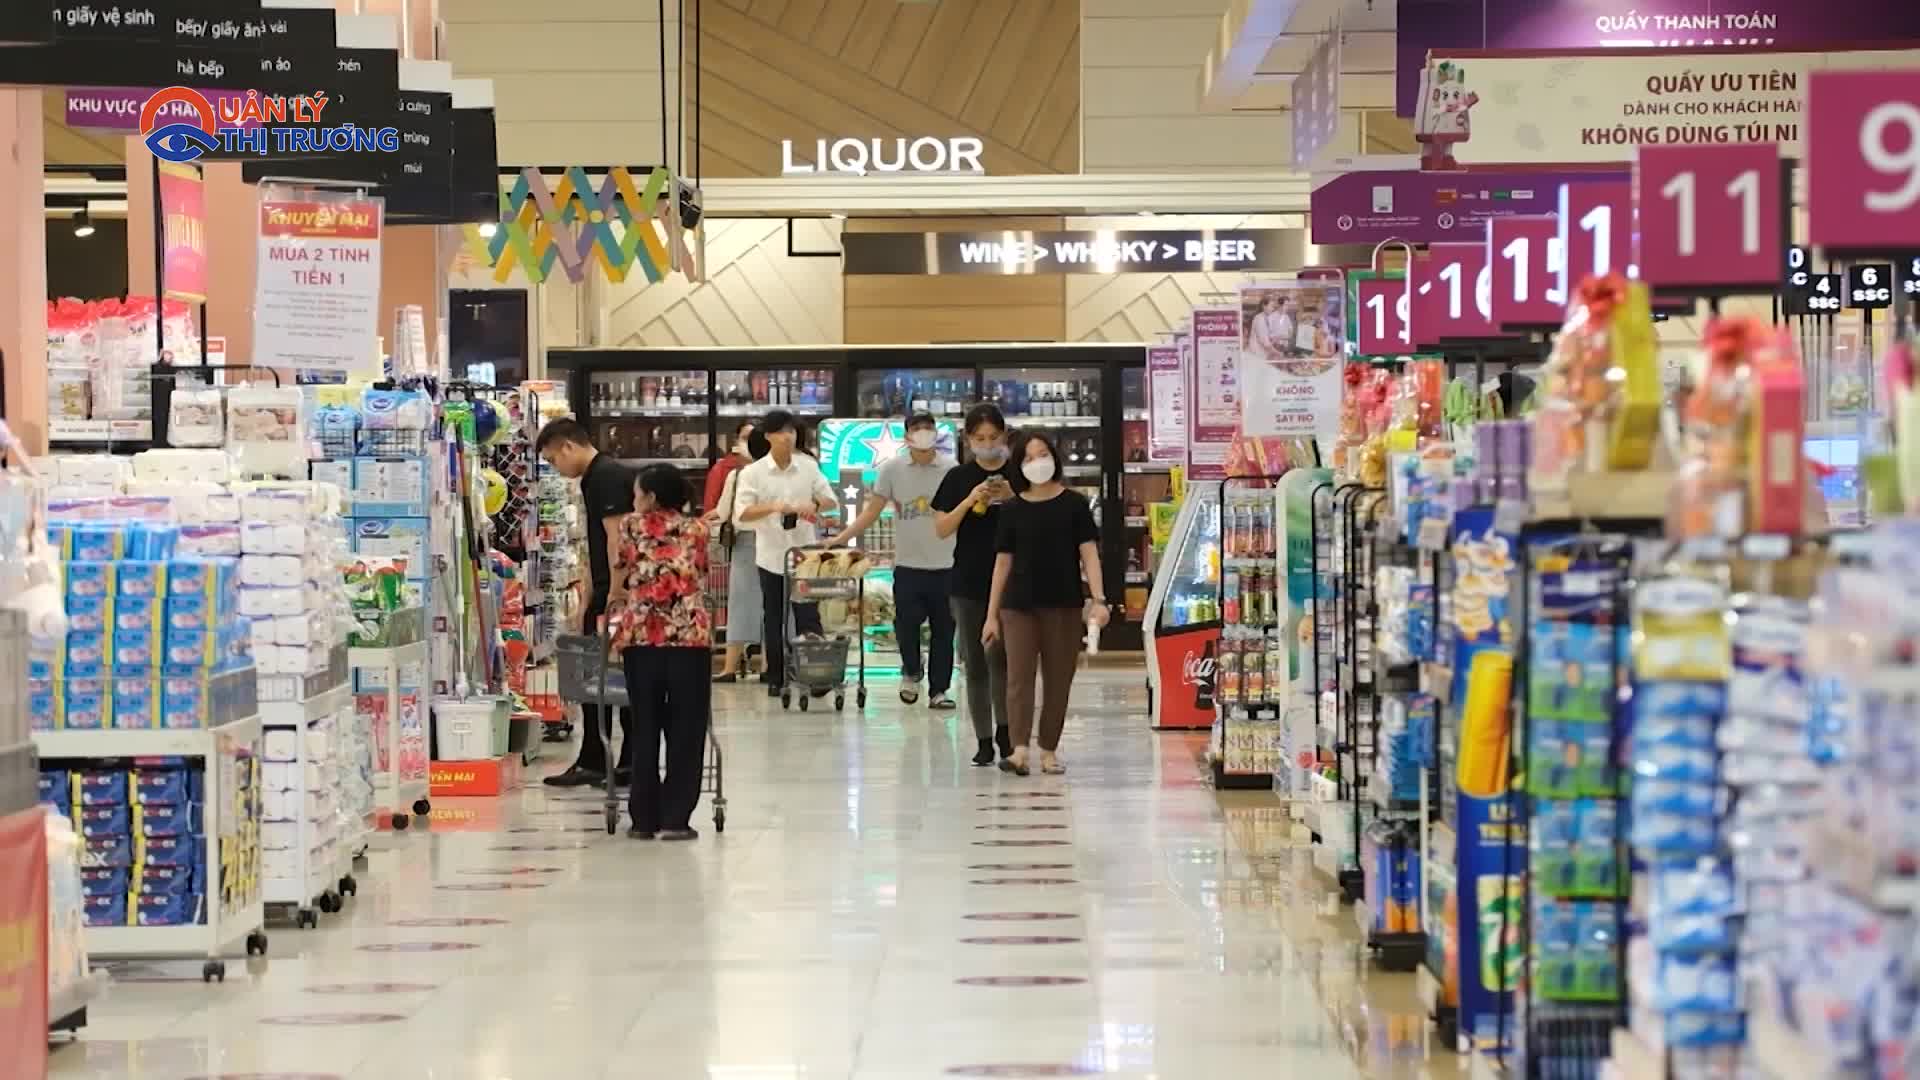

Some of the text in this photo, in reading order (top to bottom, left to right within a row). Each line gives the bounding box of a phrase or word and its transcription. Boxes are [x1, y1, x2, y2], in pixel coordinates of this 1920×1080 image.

[102, 7, 121, 27] vệ
[124, 8, 155, 25] sinh
[1654, 15, 1720, 31] THANH
[1724, 11, 1777, 30] TOÁN
[1711, 71, 1743, 92] ƯU
[1747, 69, 1797, 91] TIÊN
[68, 97, 101, 113] KHU
[105, 98, 137, 118] VỰC
[1623, 98, 1802, 116] DÀNH CHO KHÁCH HÀ
[1581, 123, 1659, 146] KHÔNG
[1666, 122, 1729, 144] DÙNG
[1733, 120, 1769, 142] TÚI
[782, 137, 985, 175] LIQUOR
[1661, 170, 1762, 257] 11
[269, 247, 308, 262] MUA
[314, 248, 323, 261] 2
[959, 240, 1257, 264] WINE WHSKY BEER
[340, 273, 345, 285] 1
[1815, 276, 1831, 295] 4
[1861, 267, 1878, 286] 6
[1807, 296, 1840, 310] SSC
[1852, 288, 1890, 302] SSC
